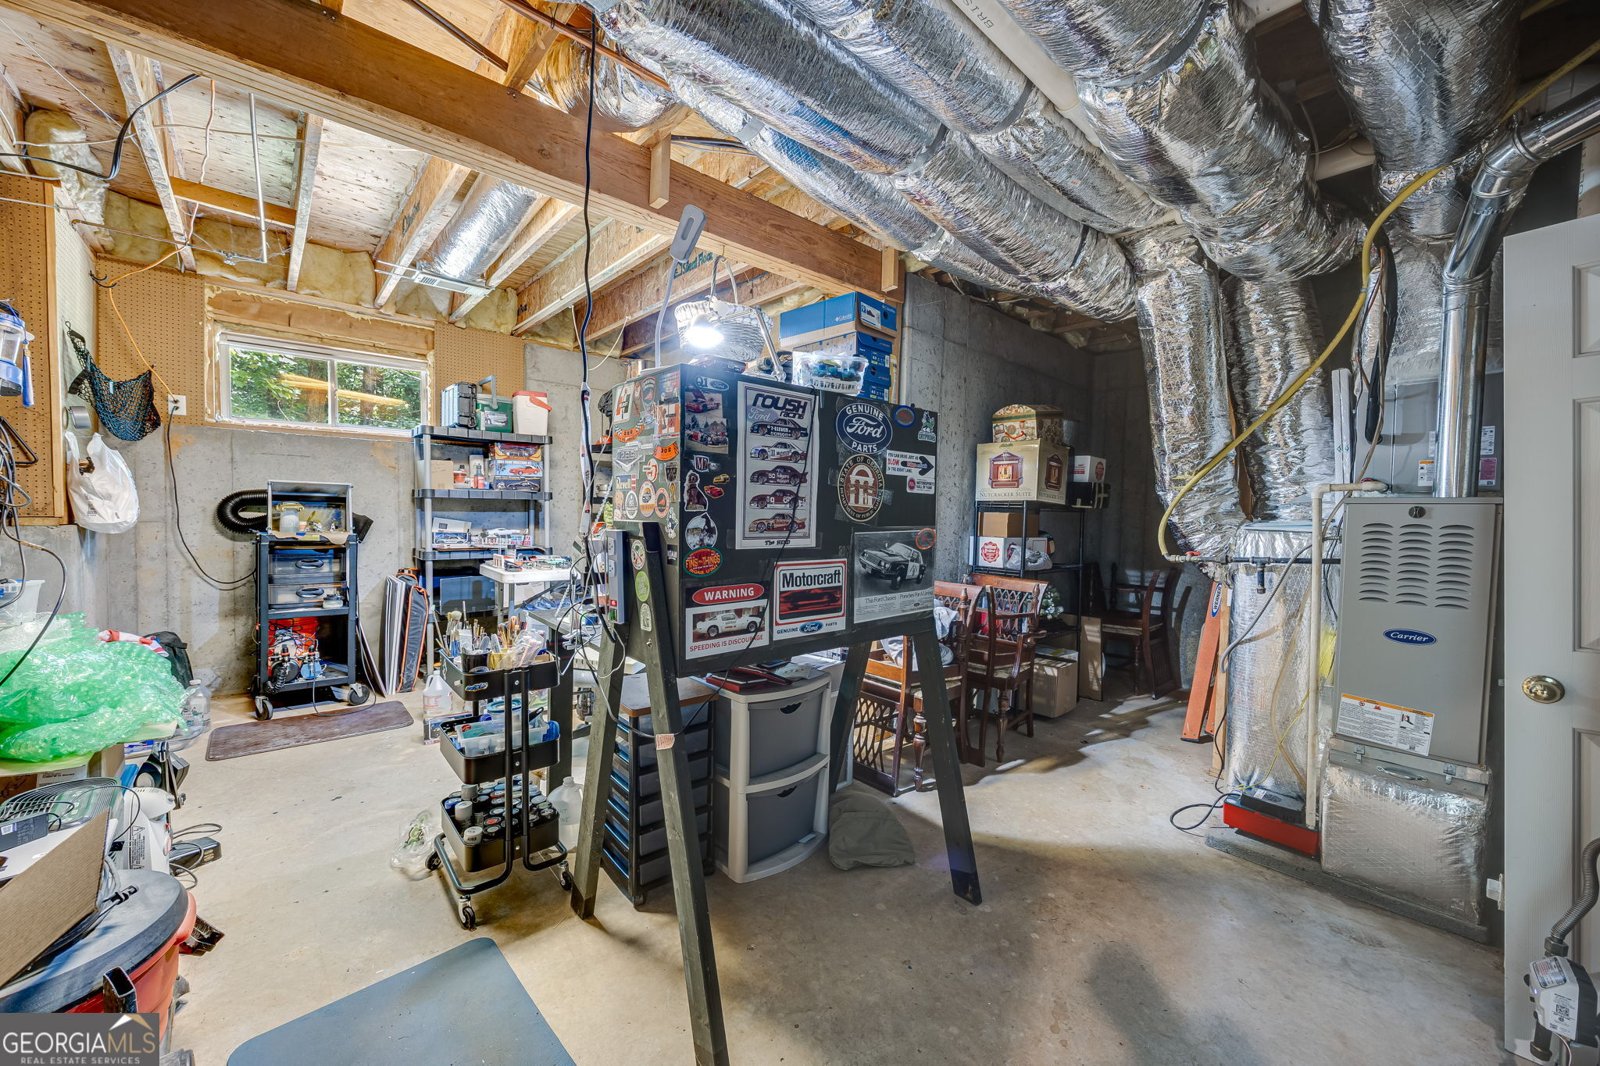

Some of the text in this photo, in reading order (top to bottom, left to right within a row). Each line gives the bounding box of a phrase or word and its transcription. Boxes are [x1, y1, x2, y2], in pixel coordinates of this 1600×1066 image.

[780, 410, 804, 420] racing
[846, 406, 883, 420] GENUINE
[846, 416, 883, 438] Ford
[852, 441, 878, 453] PARTS
[866, 458, 884, 489] GEORGIA
[782, 569, 841, 588] Motorcraft
[704, 587, 754, 601] WARNING
[803, 623, 820, 632] Ford
[1390, 632, 1429, 642] Carrier
[690, 641, 720, 652] SPEEDING
